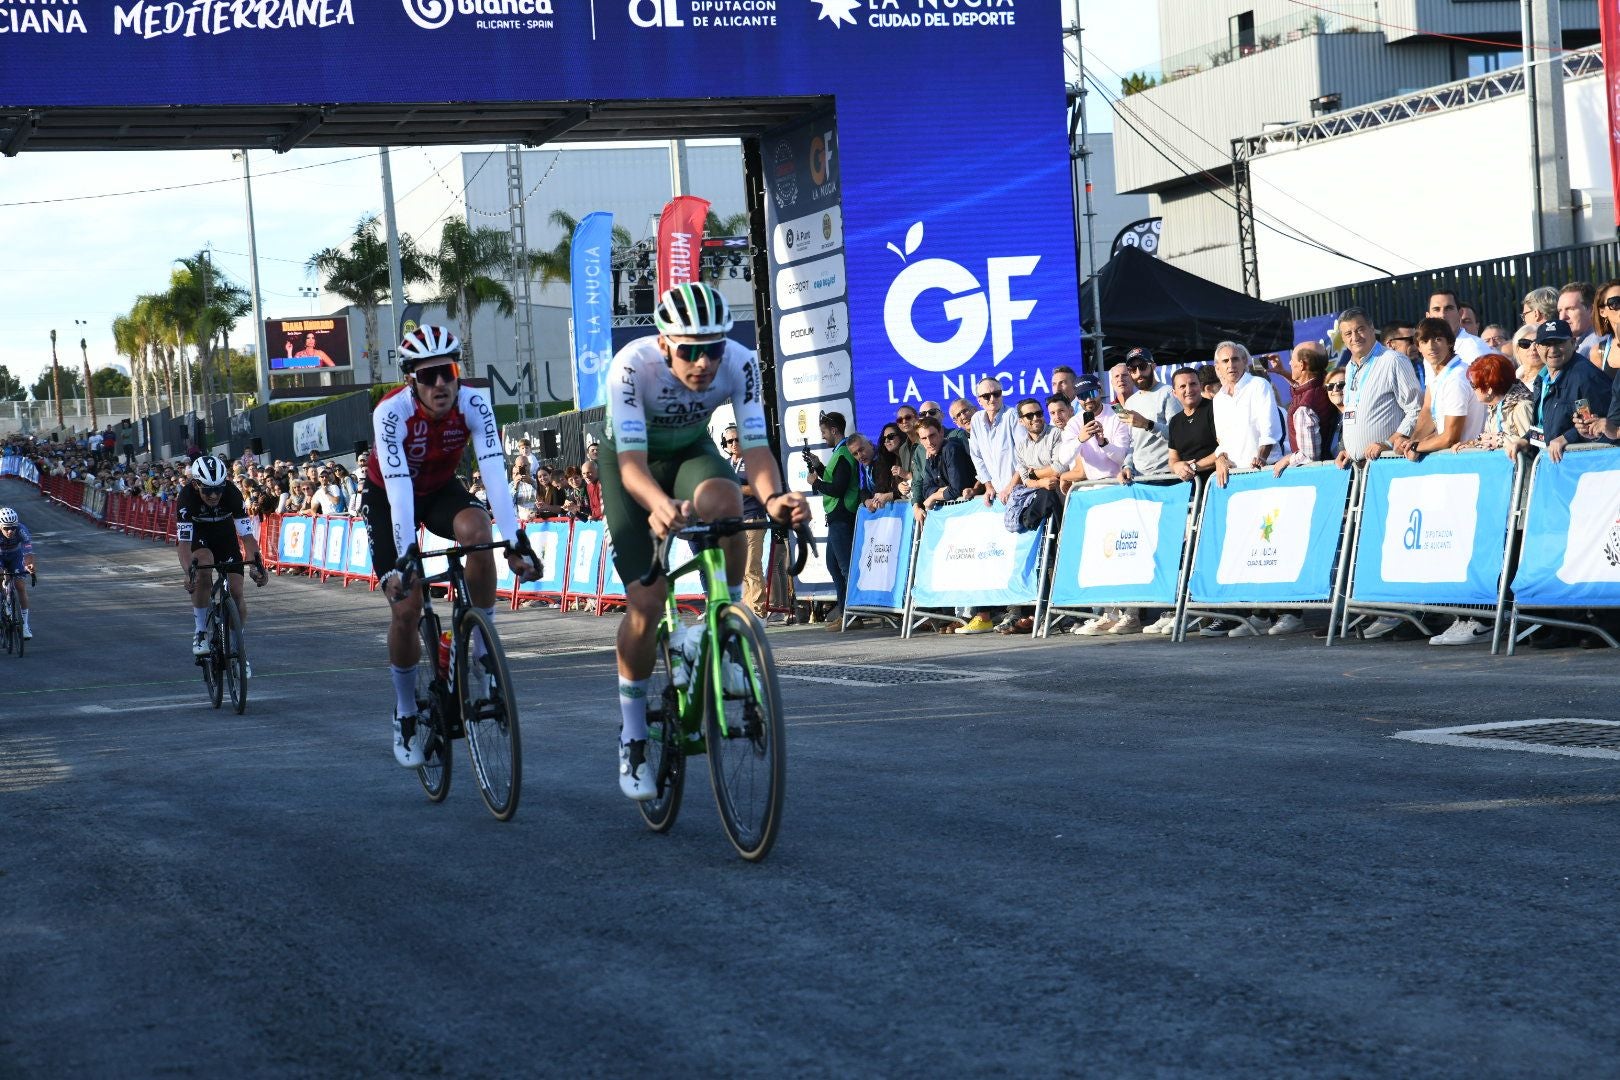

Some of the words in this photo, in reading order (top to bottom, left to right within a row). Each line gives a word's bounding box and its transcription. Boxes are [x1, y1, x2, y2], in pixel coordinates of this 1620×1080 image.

[476, 20, 521, 30] ALICANTE
[526, 20, 554, 29] SPAIN
[692, 17, 709, 27] DE
[713, 15, 777, 27] ALICANTE
[868, 13, 922, 28] CIUDAD
[924, 12, 950, 27] DEL
[952, 11, 1016, 27] DEPORTE
[587, 310, 601, 334] LA
[887, 375, 921, 404] LA
[469, 394, 497, 449] Cofidis
[381, 411, 401, 468] Cofidis
